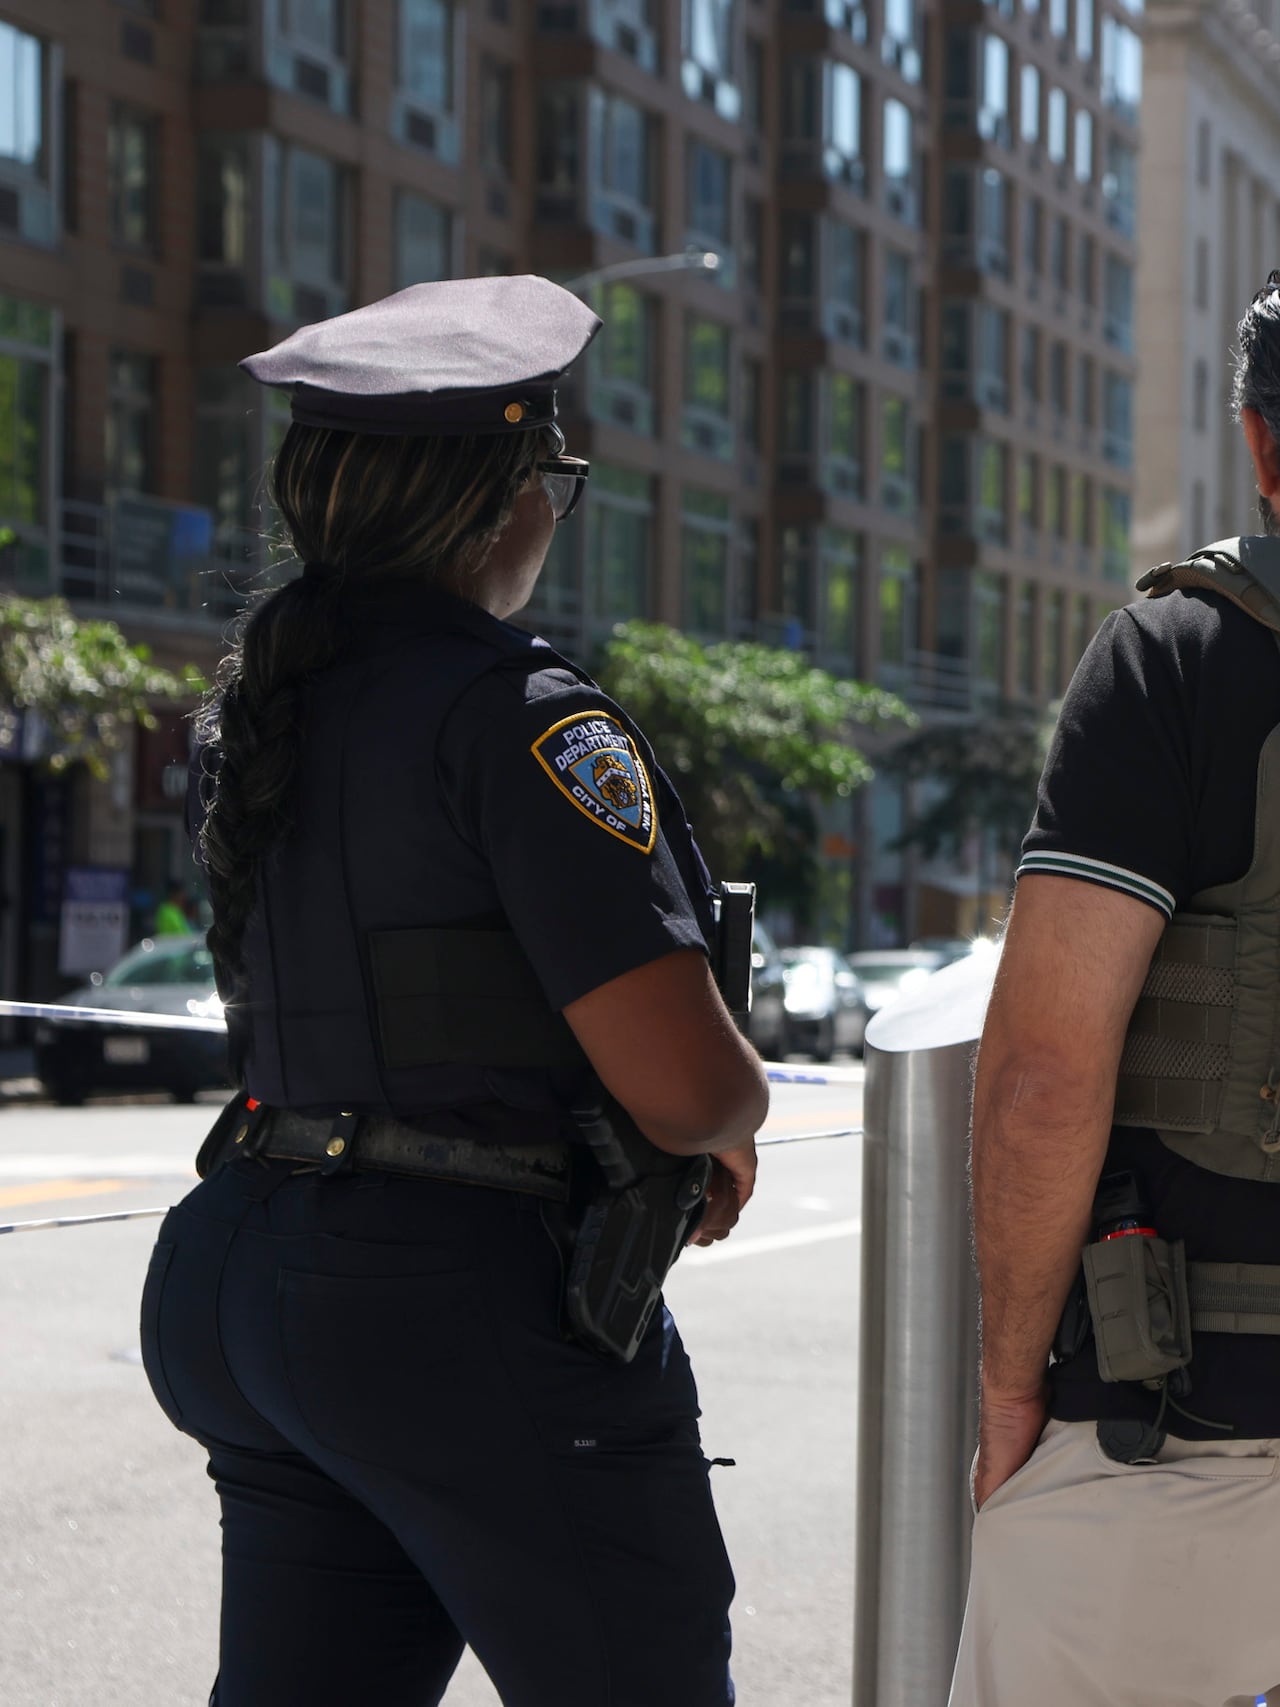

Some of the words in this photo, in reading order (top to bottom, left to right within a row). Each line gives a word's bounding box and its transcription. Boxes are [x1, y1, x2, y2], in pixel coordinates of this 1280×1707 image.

[563, 720, 611, 746] POLICE
[555, 734, 628, 771] DEPARTMENT
[572, 785, 605, 815] CITY
[606, 815, 627, 831] OF
[641, 801, 652, 831] NEW
